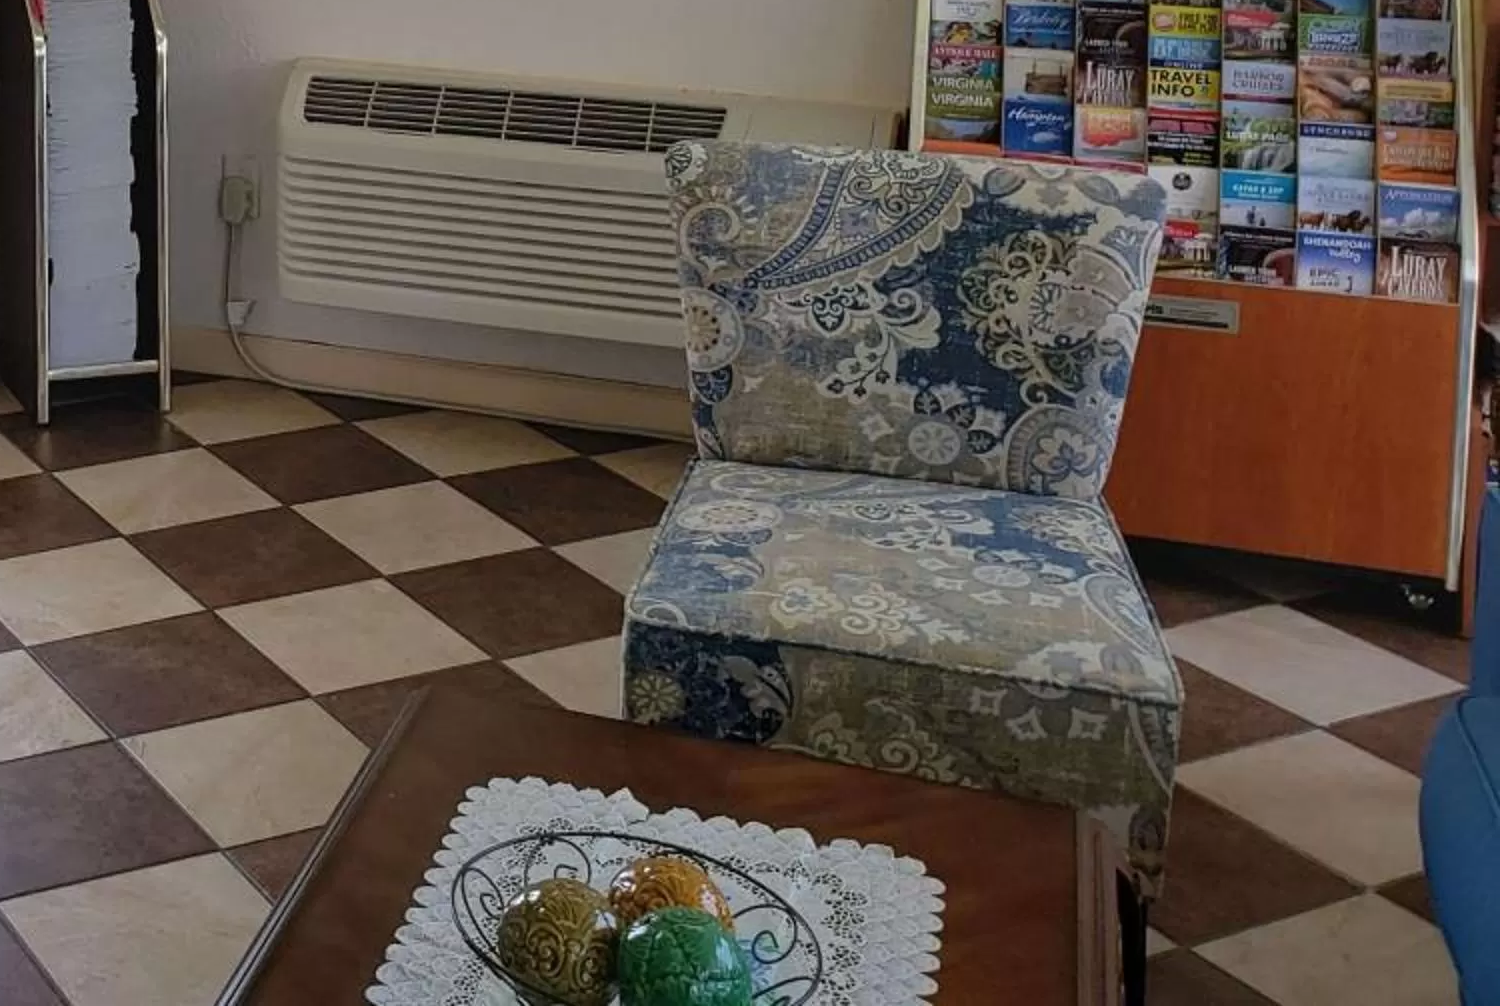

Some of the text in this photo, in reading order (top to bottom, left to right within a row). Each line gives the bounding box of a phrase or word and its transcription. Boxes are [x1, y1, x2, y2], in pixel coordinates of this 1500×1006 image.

[932, 76, 994, 92] VIRGINIA
[1085, 60, 1135, 92] LURAY
[1150, 69, 1212, 85] TRAVEL
[1151, 84, 1196, 98] INFO
[931, 92, 993, 108] VIRGINIA
[1303, 236, 1372, 250] SHENANDOAH
[1389, 244, 1448, 277] LURAY
[1386, 274, 1444, 299] CAVERNS
